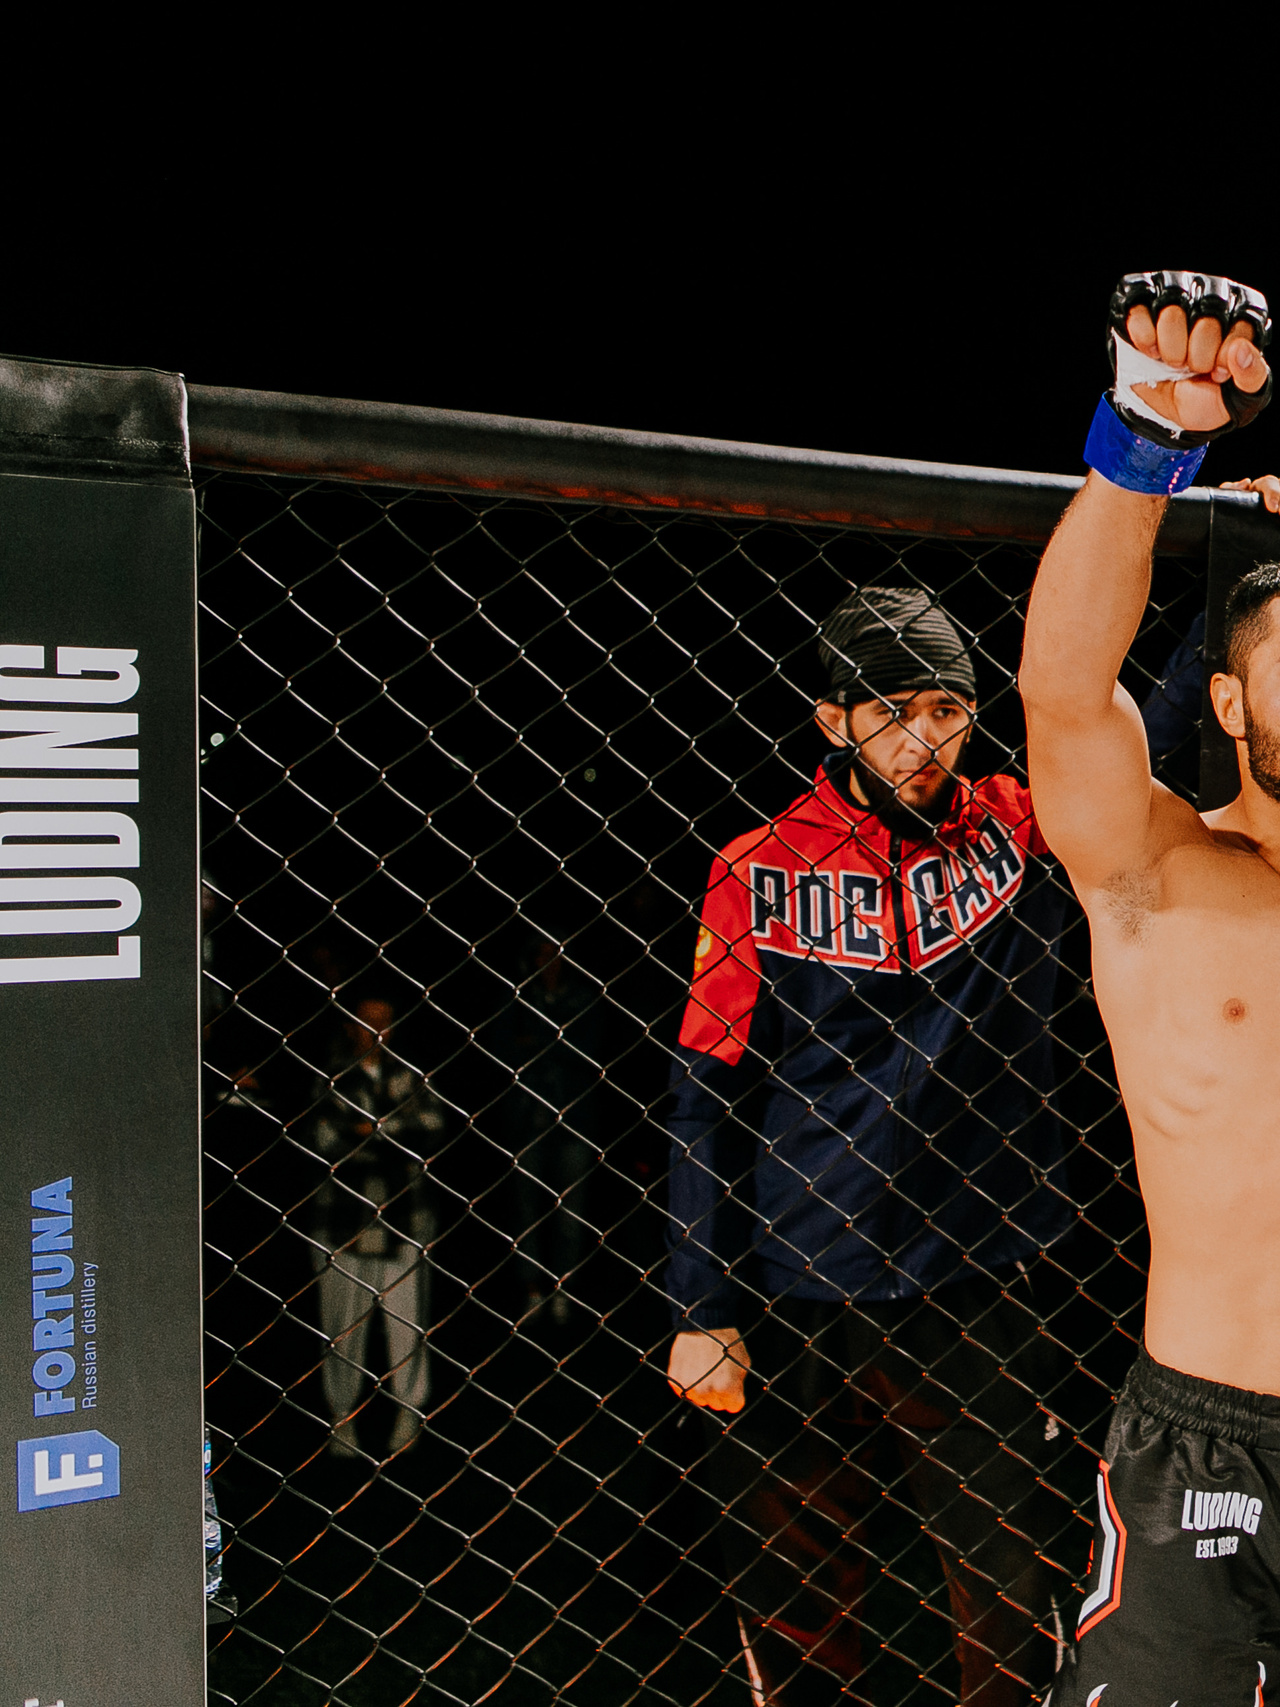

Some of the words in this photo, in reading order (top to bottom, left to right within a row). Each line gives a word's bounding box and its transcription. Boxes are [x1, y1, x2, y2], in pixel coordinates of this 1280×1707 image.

[0, 645, 142, 983] LUDING
[31, 1176, 76, 1418] FORTUNA
[80, 1262, 98, 1334] distillery
[82, 1340, 98, 1409] Russian
[1181, 1489, 1263, 1535] LUDING
